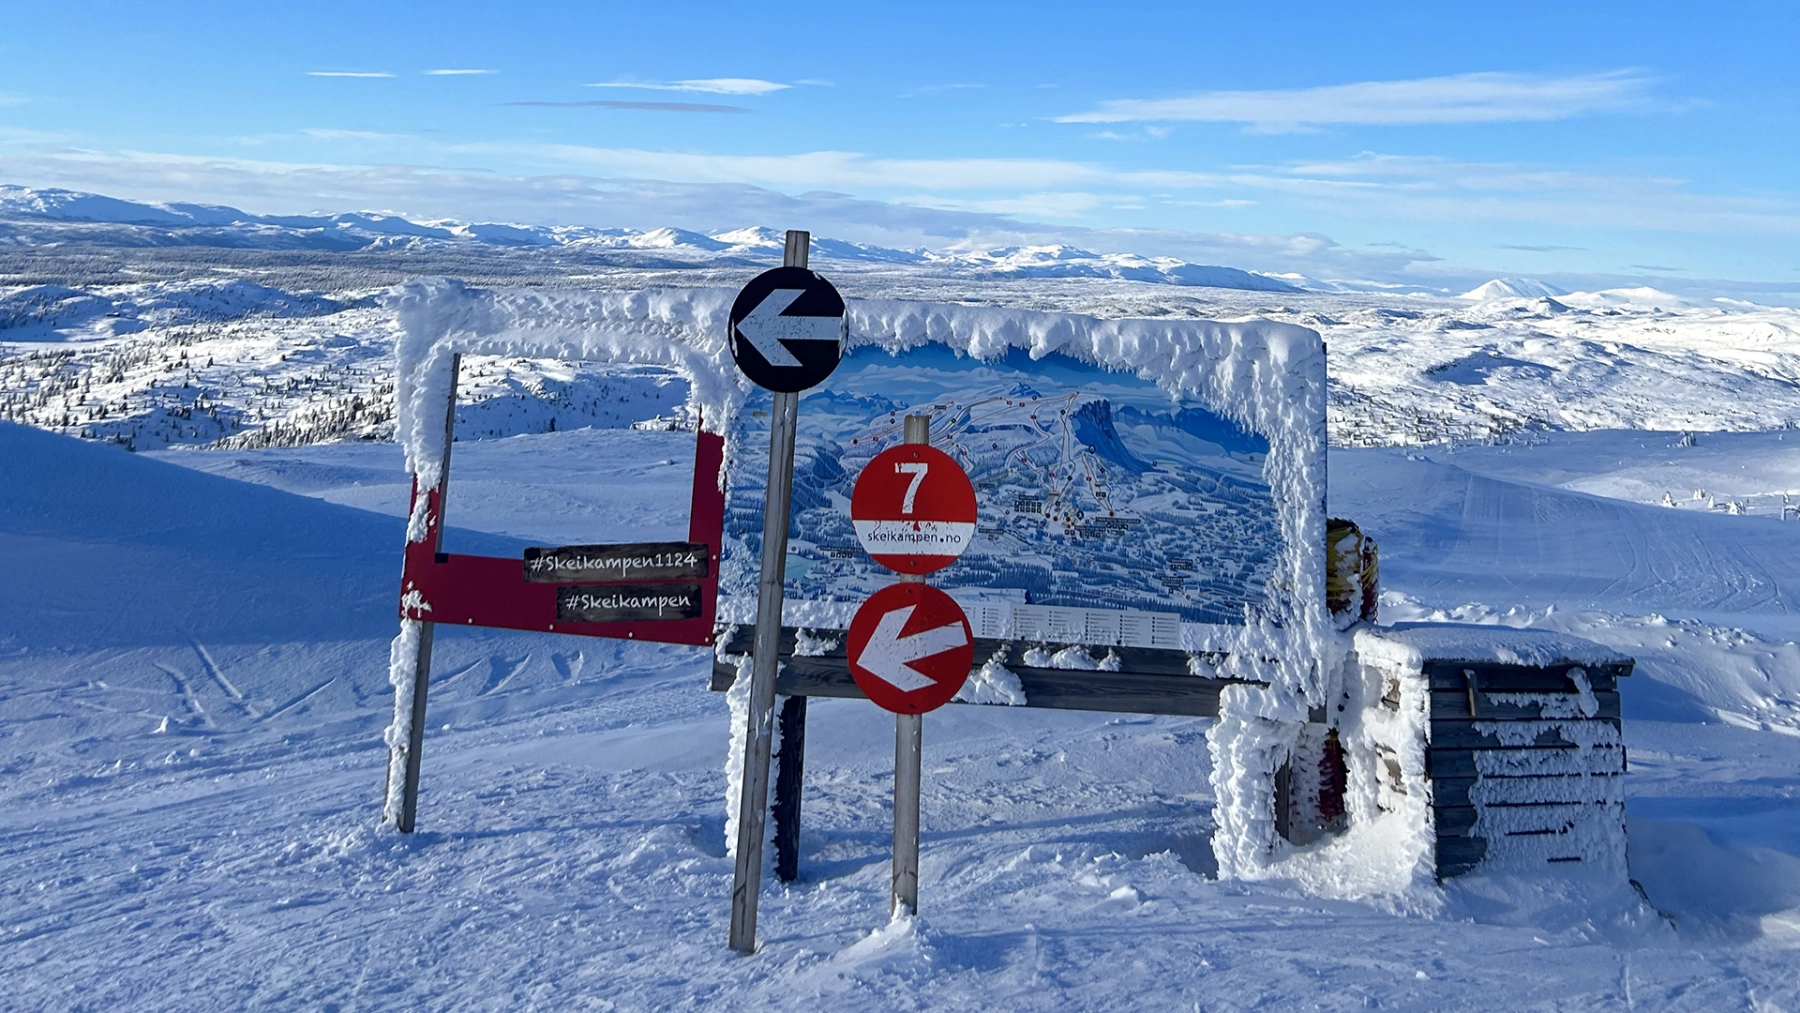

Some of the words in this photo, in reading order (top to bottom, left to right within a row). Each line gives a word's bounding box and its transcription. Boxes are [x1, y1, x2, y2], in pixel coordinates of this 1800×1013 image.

[895, 462, 928, 514] 7
[867, 530, 961, 544] skeikampen.no
[530, 552, 698, 577] #Skeikampen1124
[565, 593, 692, 616] #Skeikampen
